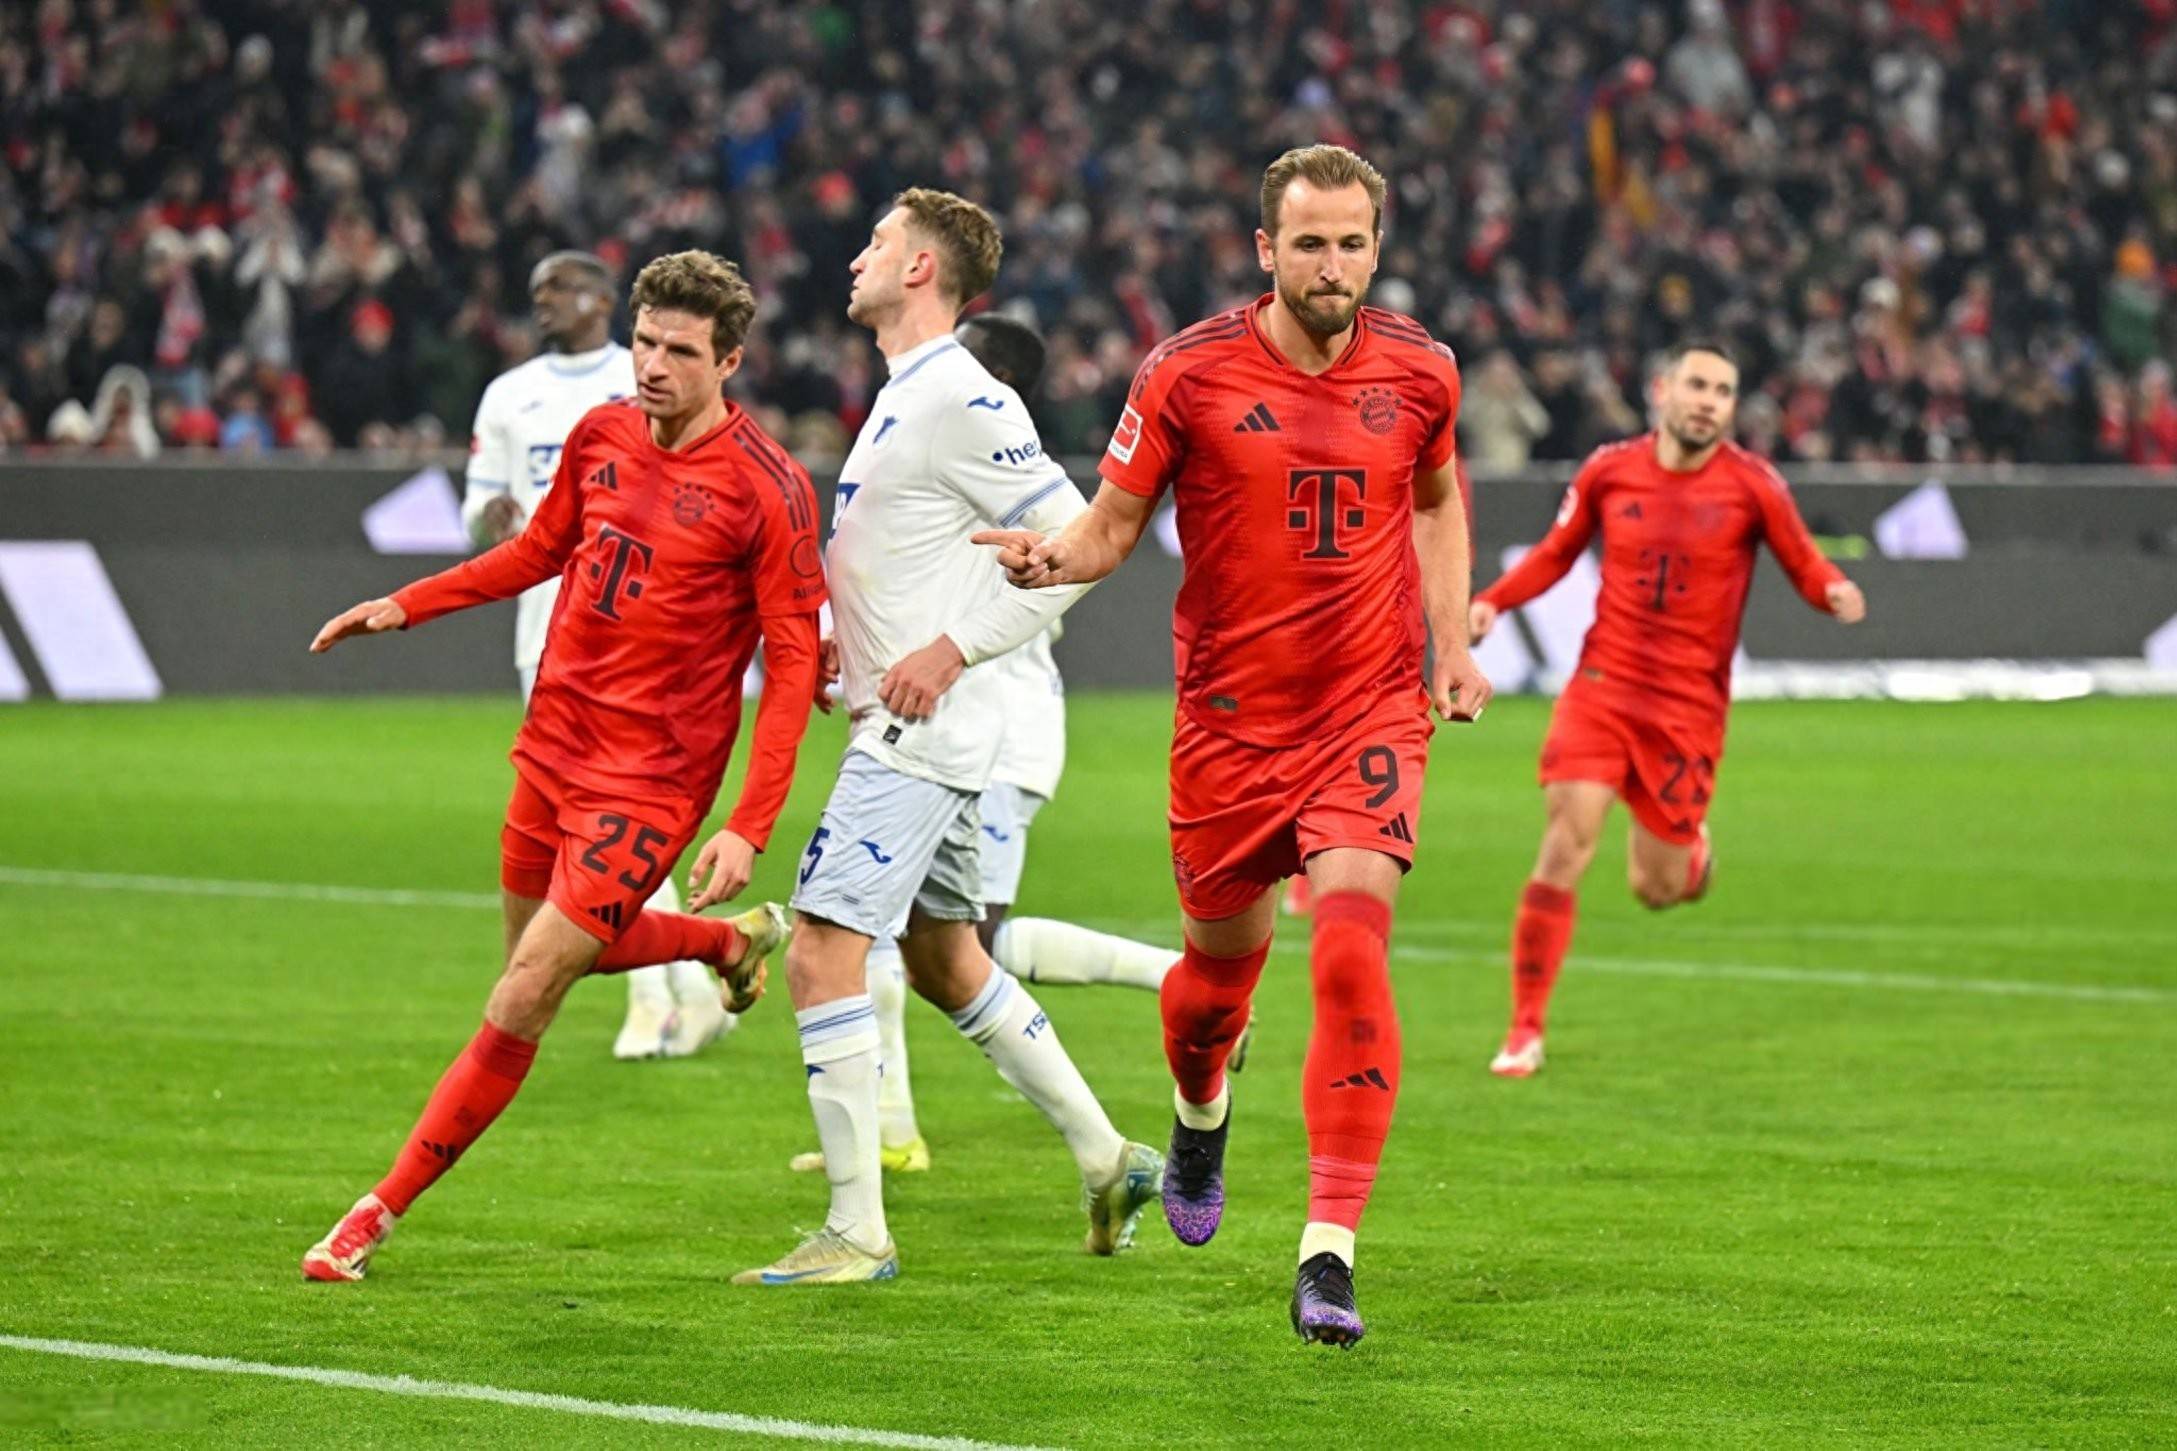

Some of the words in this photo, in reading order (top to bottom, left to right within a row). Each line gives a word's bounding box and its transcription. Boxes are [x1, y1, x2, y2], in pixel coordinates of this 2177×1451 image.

[1004, 440, 1042, 465] he
[1288, 468, 1366, 559] T
[591, 523, 655, 622] T
[1358, 745, 1400, 809] 9
[581, 814, 668, 892] 25
[801, 827, 830, 885] 5
[1022, 1010, 1047, 1039] TS
